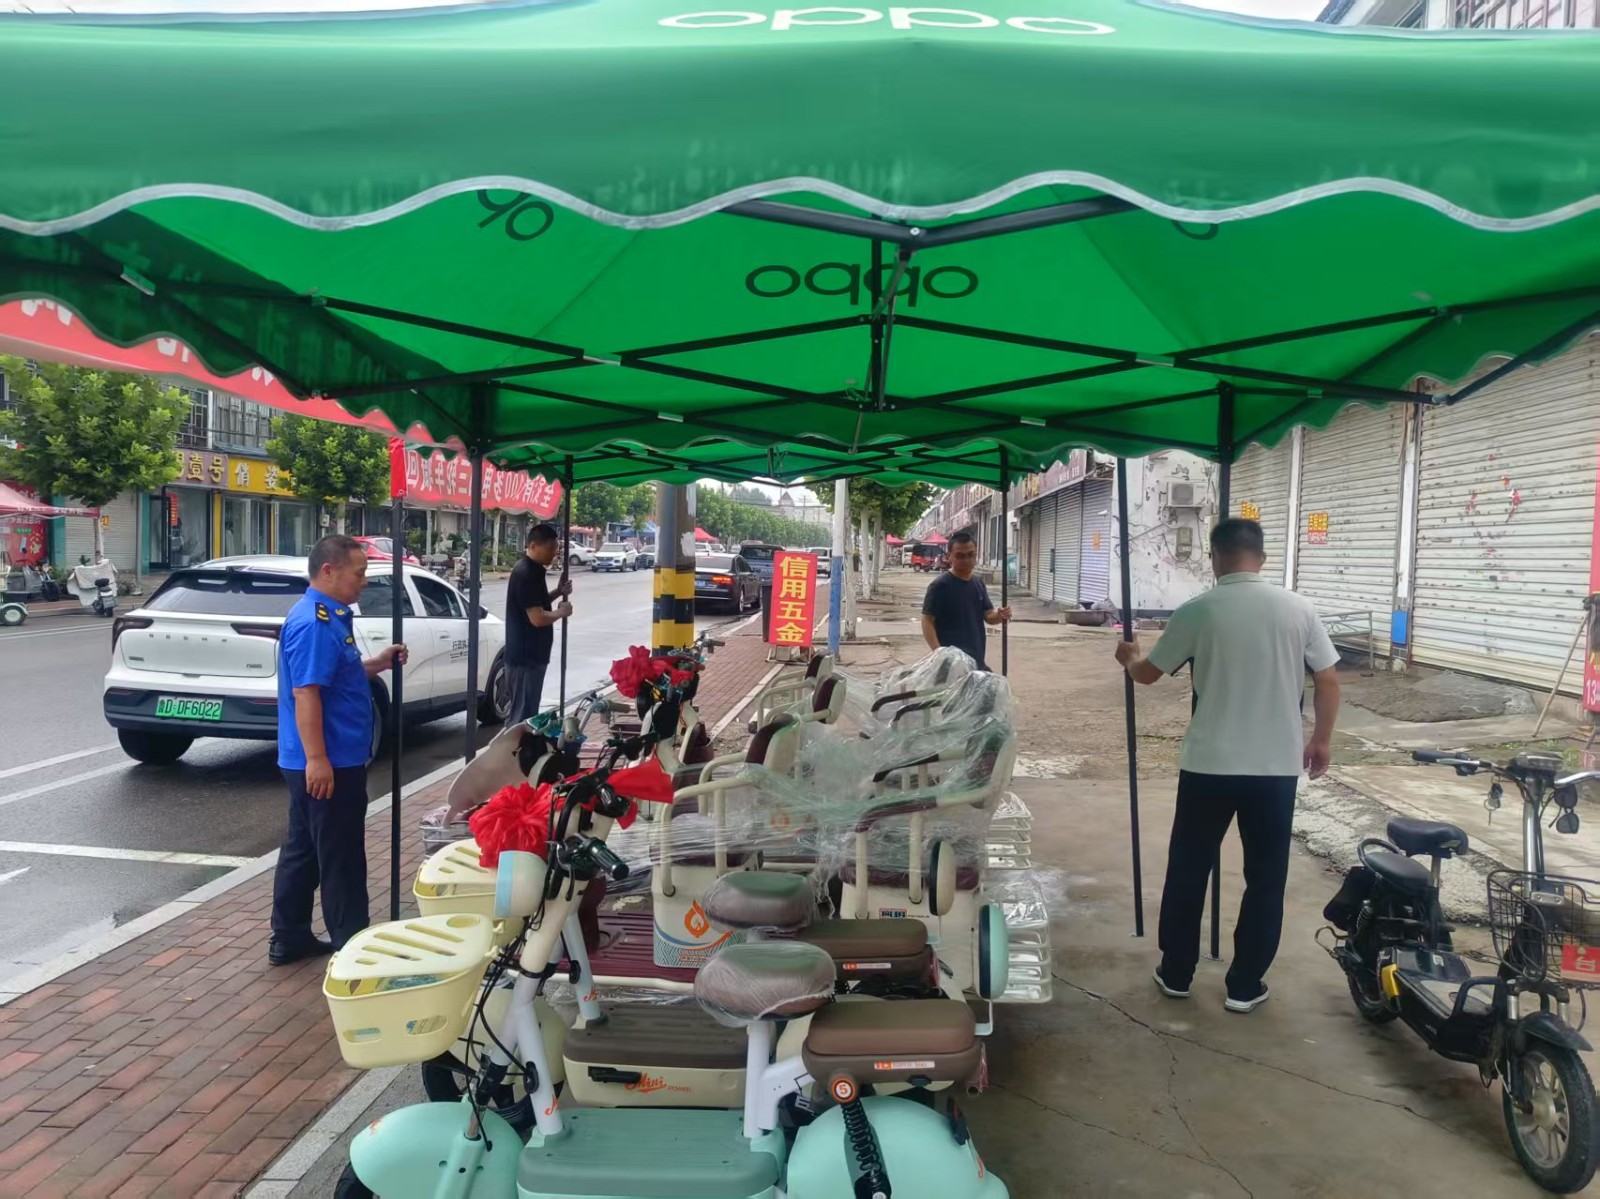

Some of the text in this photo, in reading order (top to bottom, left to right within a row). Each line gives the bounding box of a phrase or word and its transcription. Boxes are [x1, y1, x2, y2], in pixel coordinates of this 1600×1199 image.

[657, 6, 1116, 35] oppo
[775, 556, 811, 643] 信用五金
